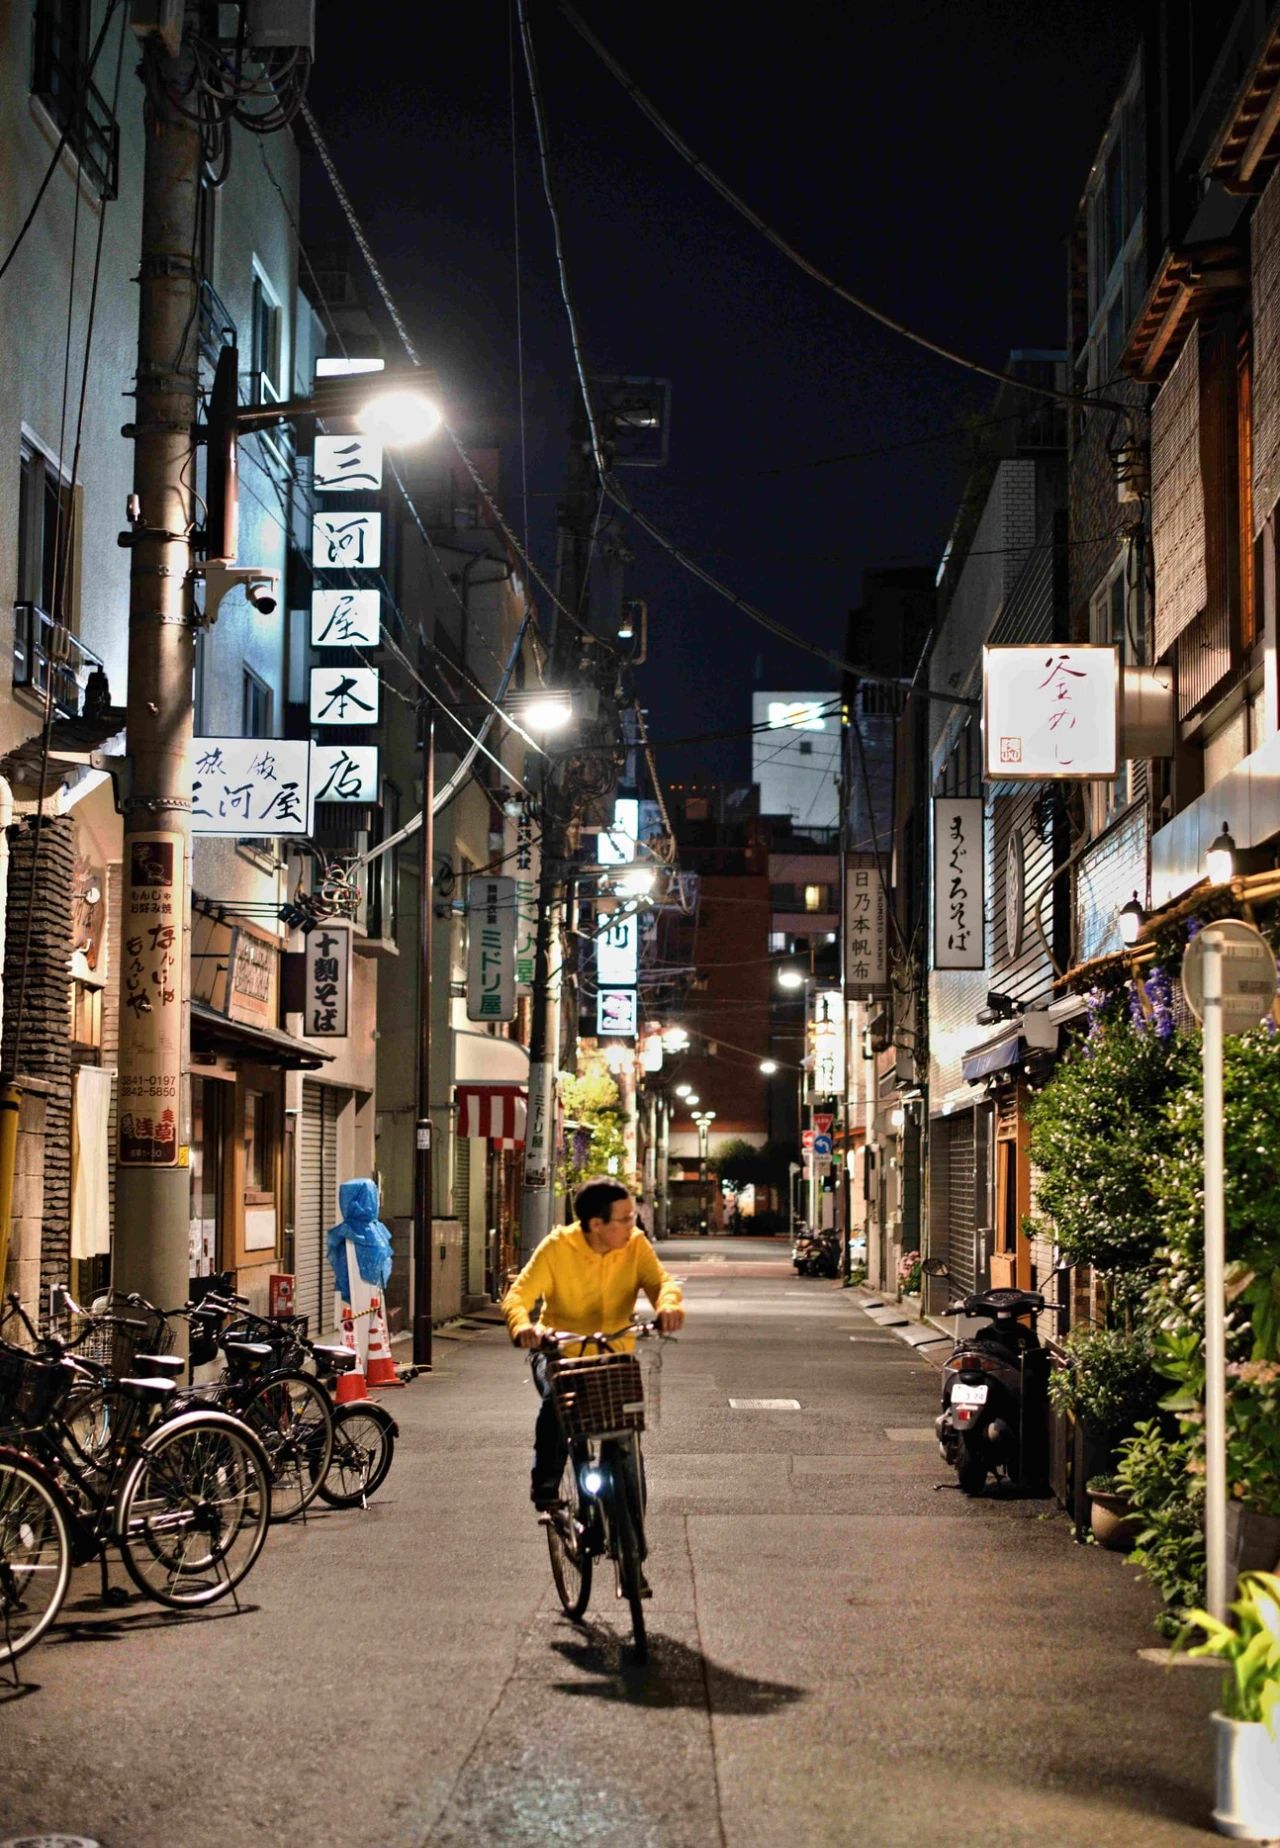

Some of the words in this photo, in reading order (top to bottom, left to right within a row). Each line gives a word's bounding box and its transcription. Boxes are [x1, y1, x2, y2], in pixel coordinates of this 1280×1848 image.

[315, 442, 379, 800] 三河屋本店
[1037, 655, 1087, 765] 釜めし
[131, 903, 172, 914] お好み焼
[852, 871, 872, 981] 日乃本帆布
[948, 816, 971, 952] まぐろそば
[314, 933, 339, 1032] 十割そば
[480, 930, 501, 1015] ミドリ屋
